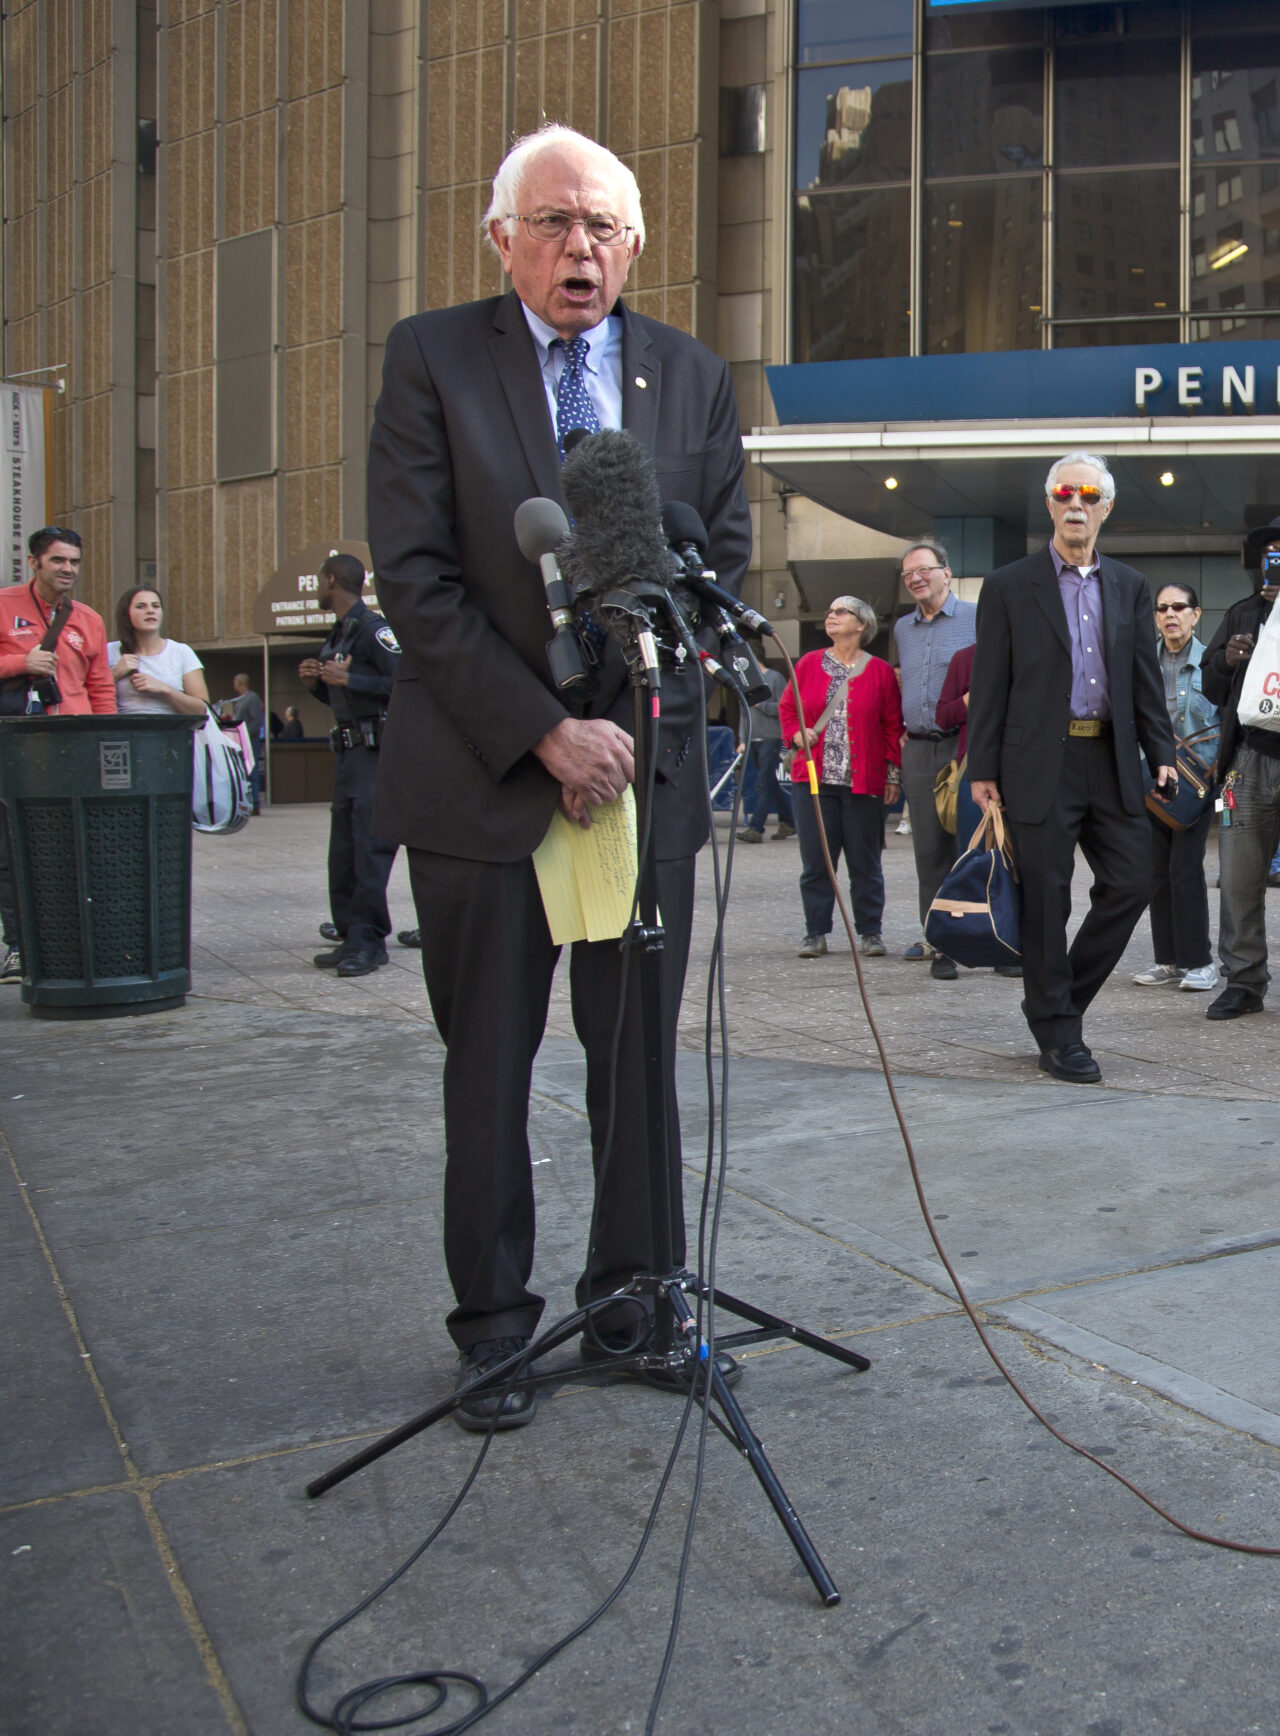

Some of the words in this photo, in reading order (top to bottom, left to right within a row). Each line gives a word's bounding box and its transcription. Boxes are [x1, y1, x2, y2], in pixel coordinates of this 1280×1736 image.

[12, 391, 21, 412] NICK
[12, 457, 22, 538] STEAKHOUSE
[12, 559, 22, 584] BAR
[271, 600, 305, 612] ENTRANCE
[305, 599, 319, 609] FOR
[275, 615, 305, 626] PATRONS
[306, 613, 324, 624] WITH
